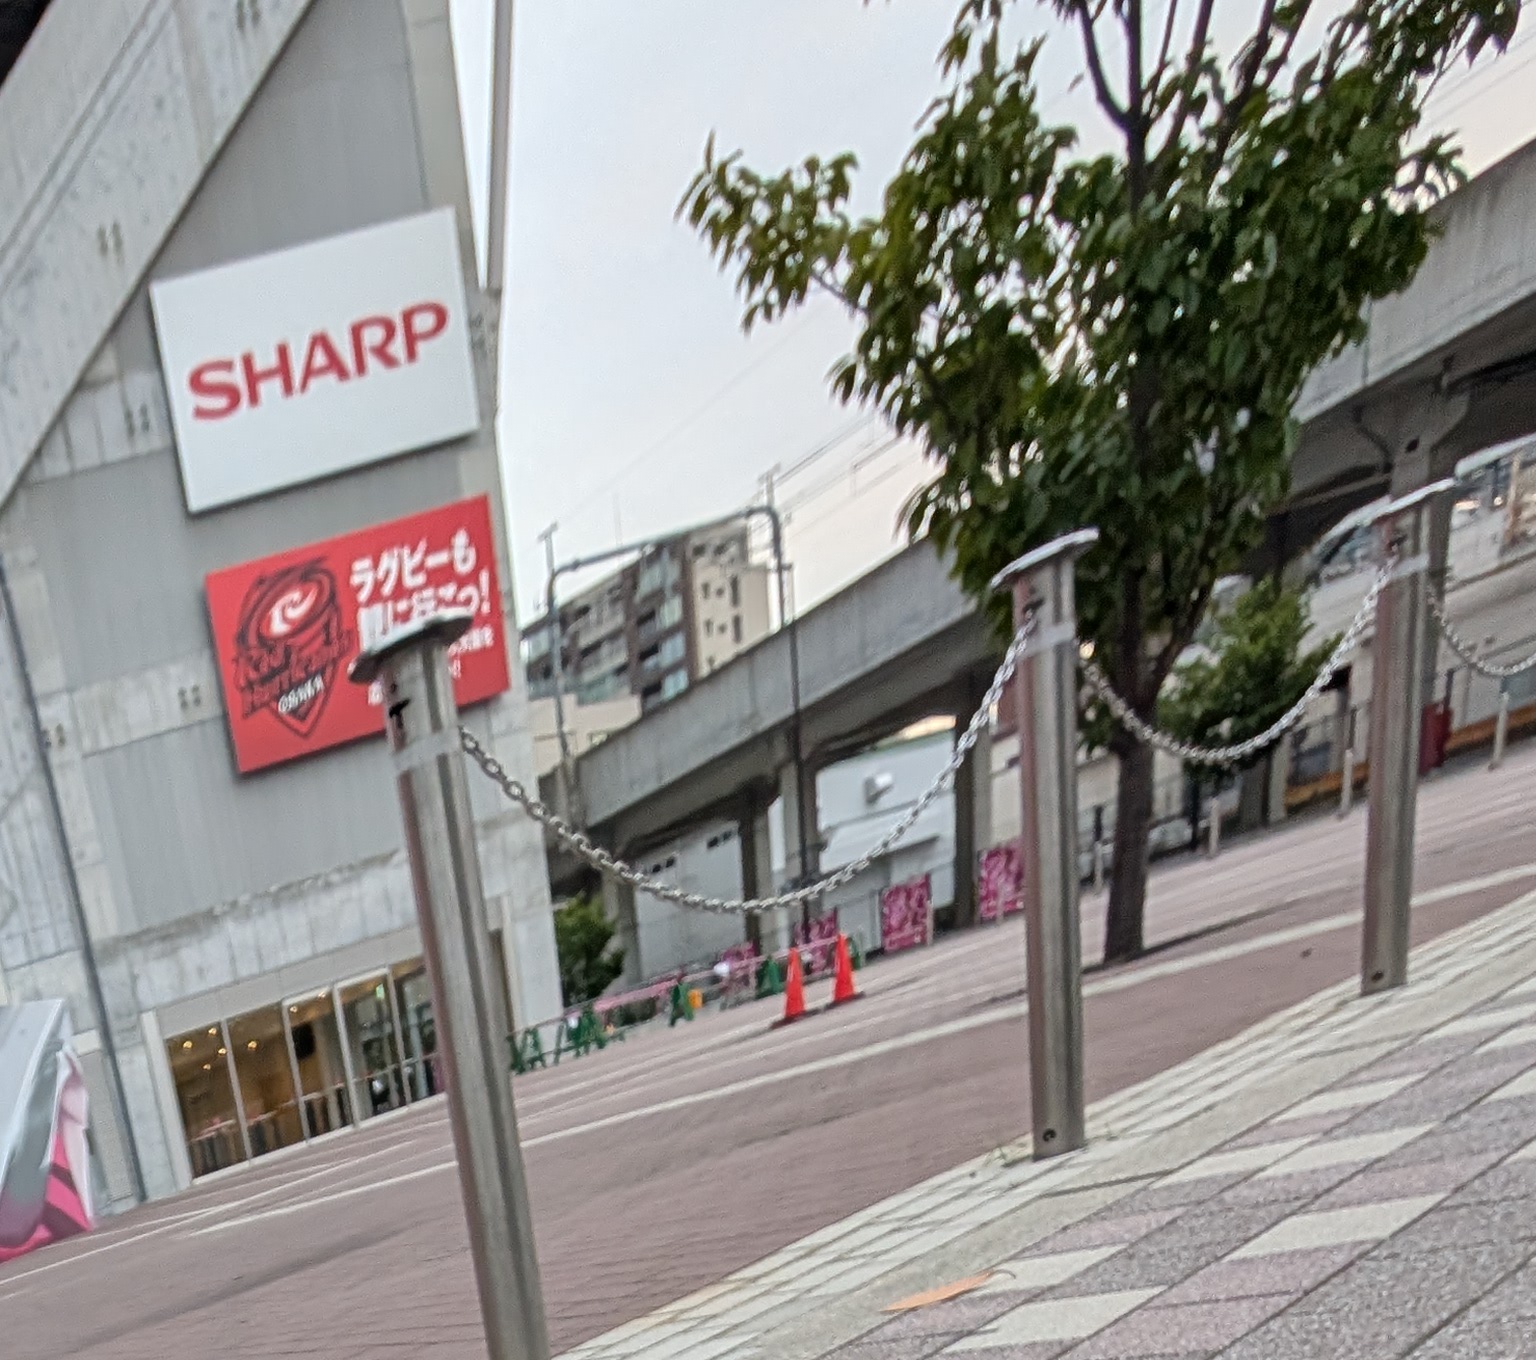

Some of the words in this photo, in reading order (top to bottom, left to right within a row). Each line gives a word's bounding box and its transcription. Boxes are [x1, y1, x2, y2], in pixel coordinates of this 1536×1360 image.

[187, 302, 449, 421] SHARP
[350, 528, 477, 604] ラグビーも
